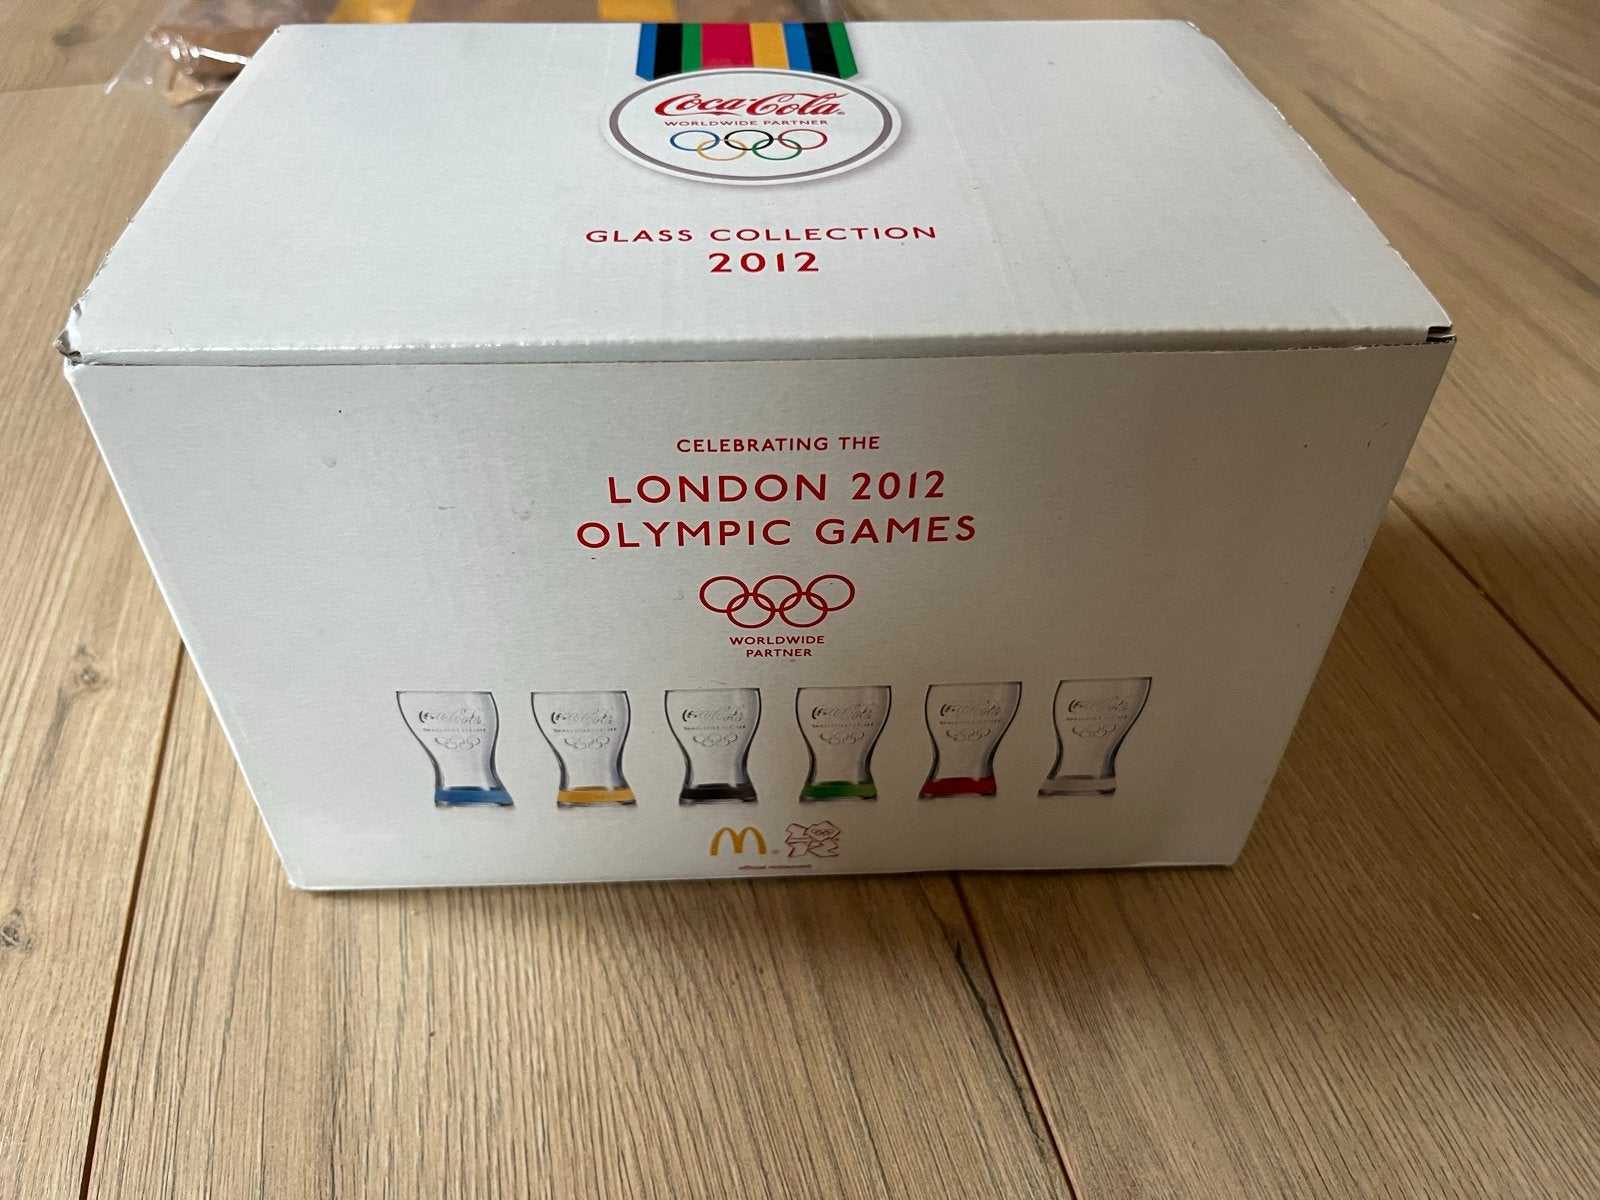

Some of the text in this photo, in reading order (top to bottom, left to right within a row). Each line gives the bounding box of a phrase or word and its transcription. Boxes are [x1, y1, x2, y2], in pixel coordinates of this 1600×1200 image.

[585, 226, 937, 243] GLASS COLLECTION
[708, 252, 819, 273] 2012
[676, 435, 881, 453] CELEBRATING THE
[608, 470, 946, 505] LONDON 2012
[576, 514, 977, 549] OLYMPIC GAMES
[729, 635, 826, 646] WORLDWIDE
[745, 648, 814, 658] PARTNER
